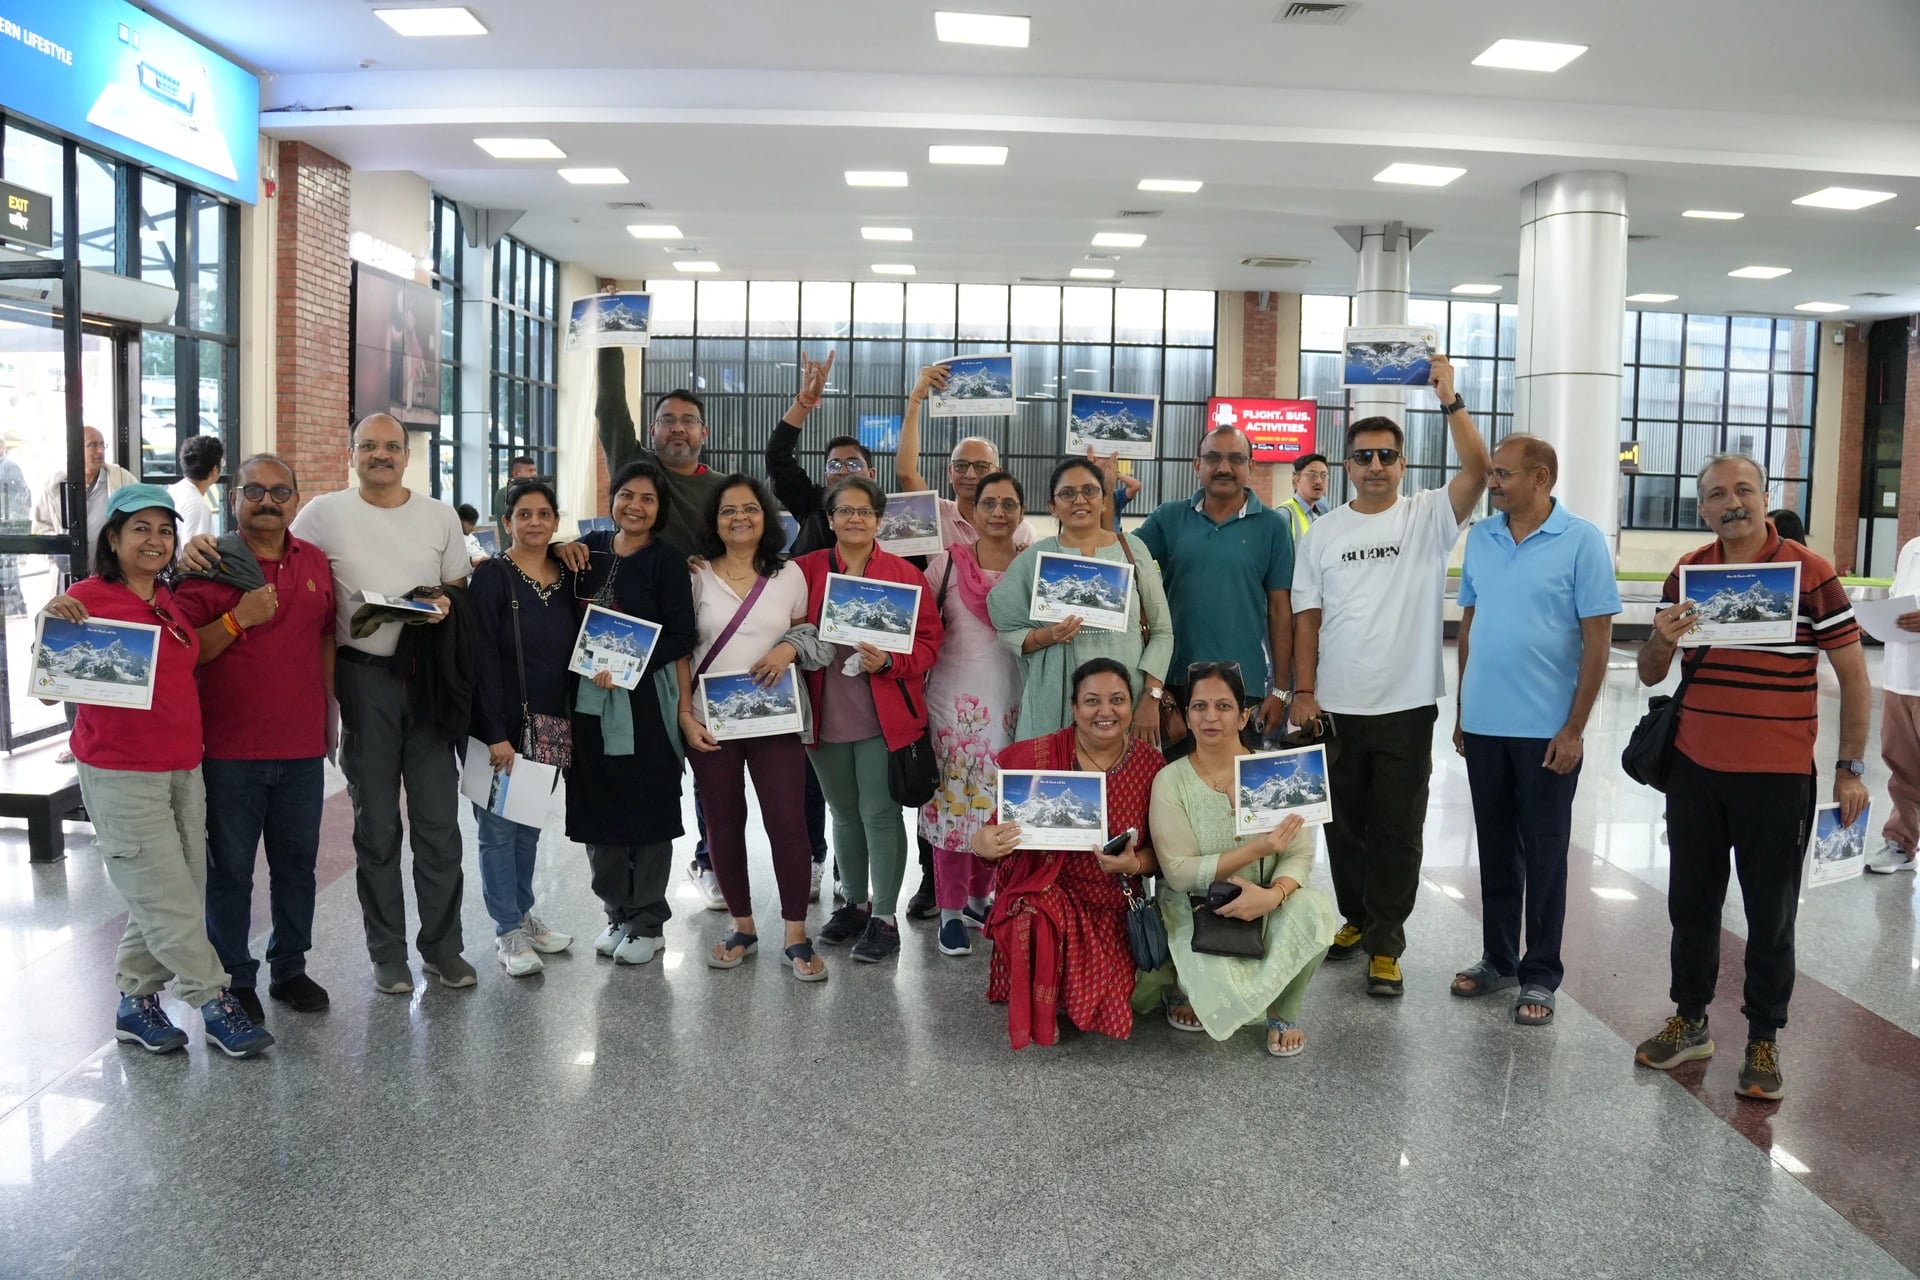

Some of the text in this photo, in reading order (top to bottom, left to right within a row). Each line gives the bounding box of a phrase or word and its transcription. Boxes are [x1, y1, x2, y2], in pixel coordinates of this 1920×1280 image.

[23, 28, 73, 66] LIFESTYLE
[8, 195, 29, 212] EXIT
[1243, 409, 1311, 421] FLIGHT. BUS.
[1245, 422, 1308, 433] ACTIVITIES.
[1632, 444, 1638, 465] 1
